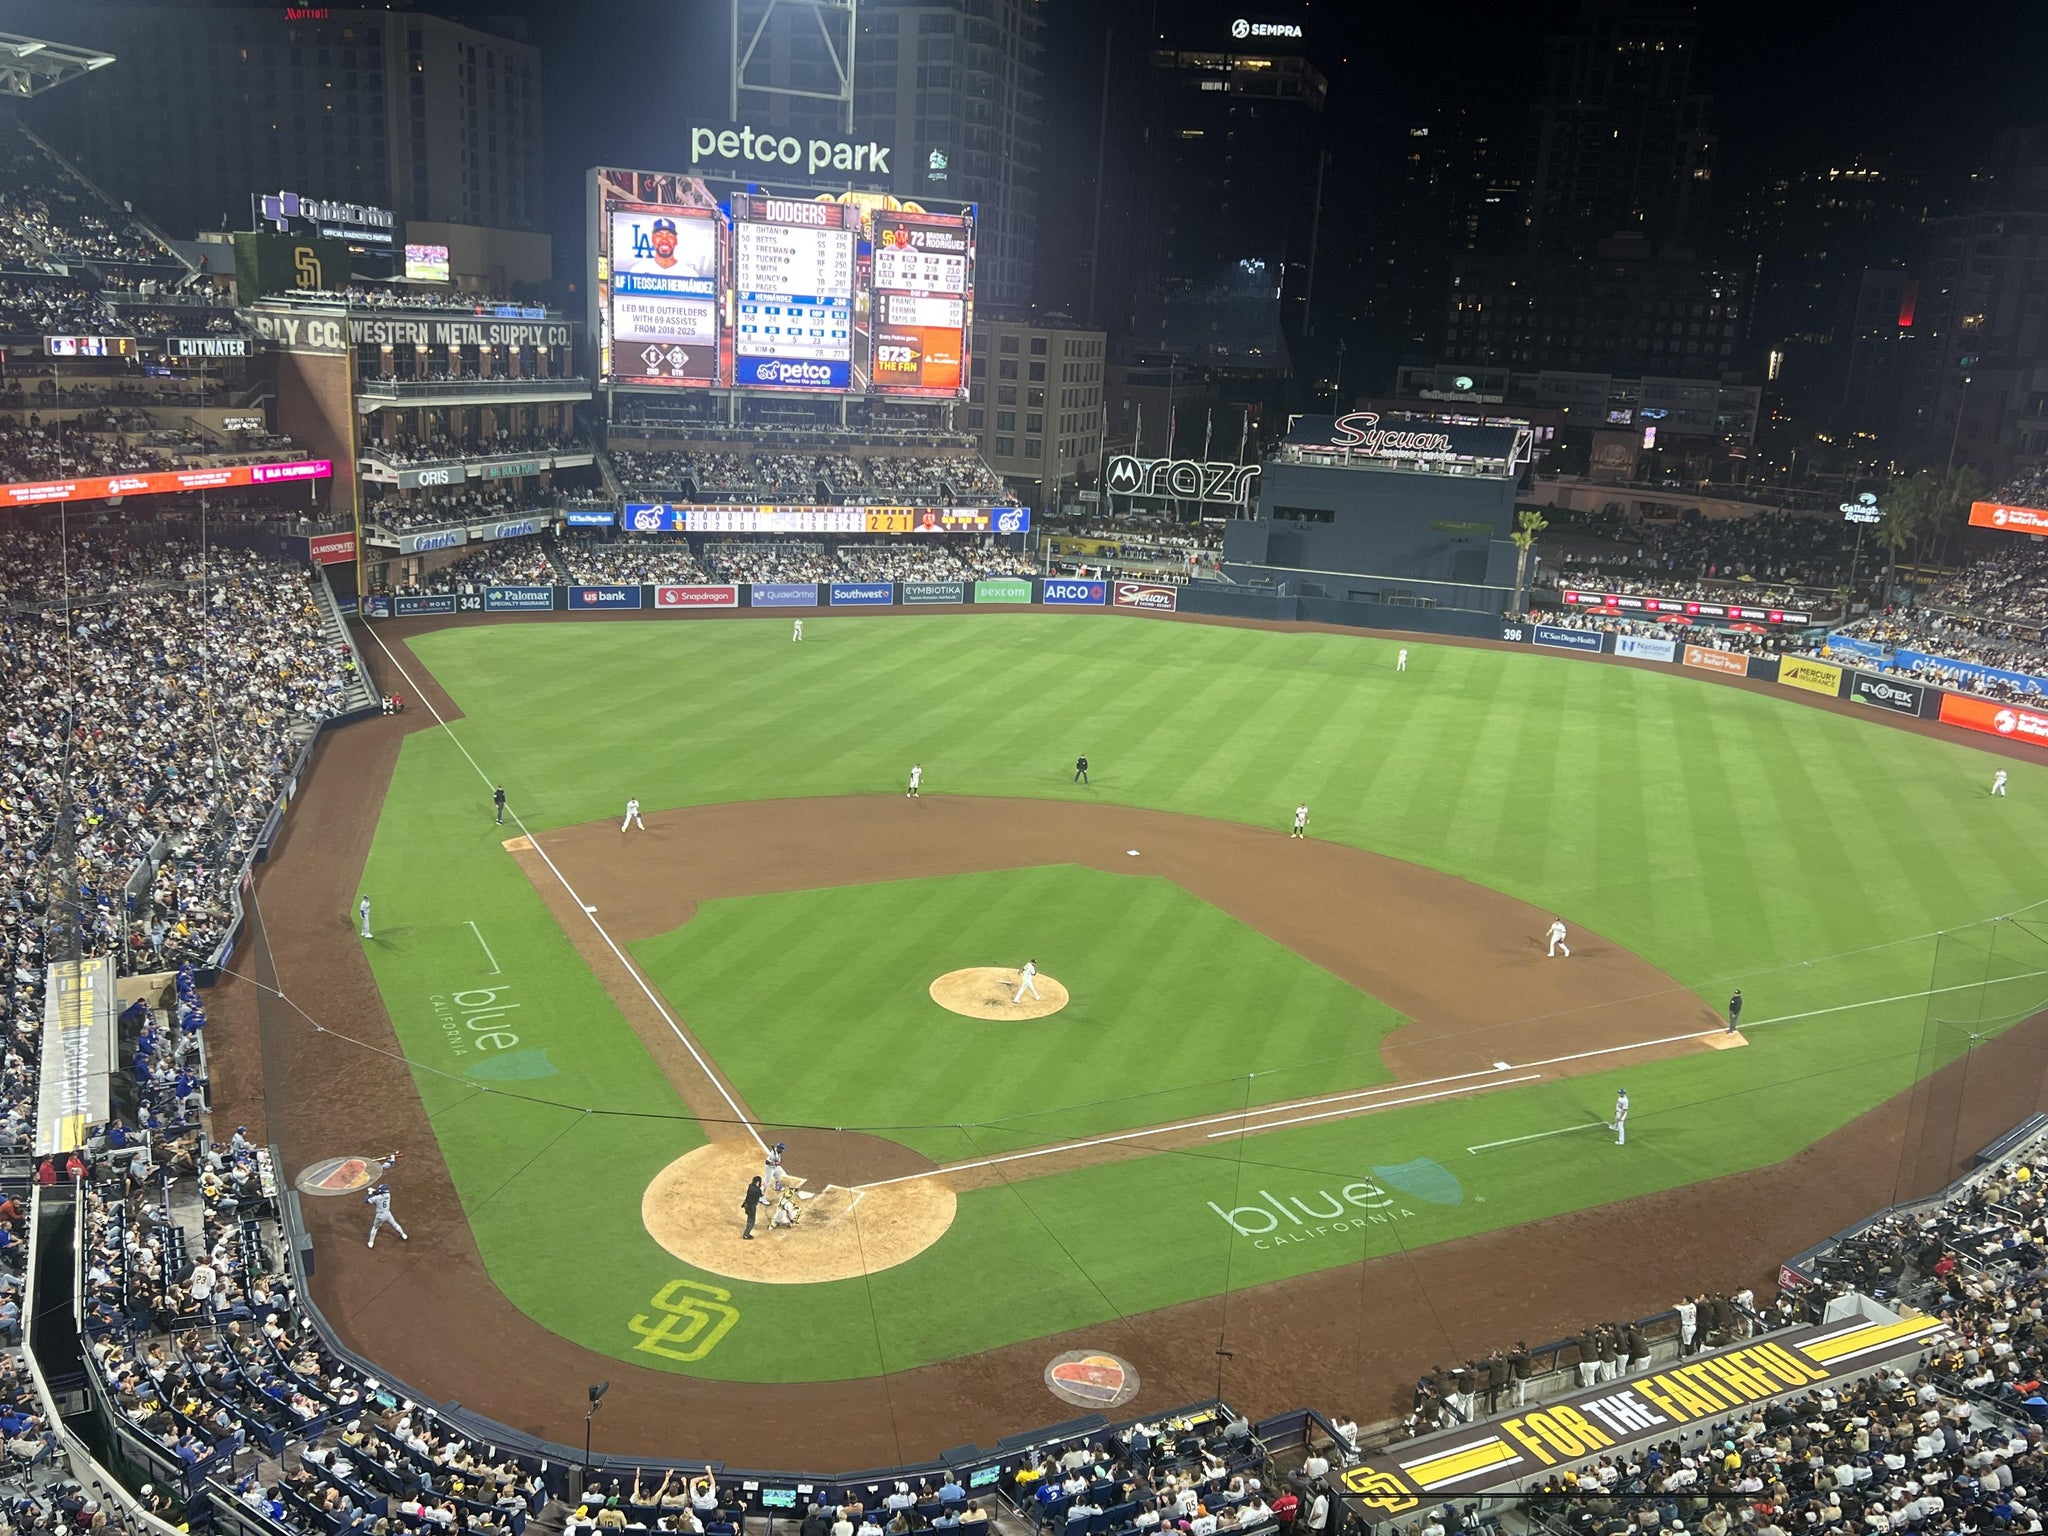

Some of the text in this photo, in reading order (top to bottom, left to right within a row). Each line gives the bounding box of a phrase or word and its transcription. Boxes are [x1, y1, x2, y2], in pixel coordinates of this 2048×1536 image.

[285, 7, 328, 20] Marriott
[1251, 23, 1302, 37] SEMPRA
[691, 125, 890, 174] petco park
[300, 197, 393, 228] QuidelOrtho
[766, 200, 826, 225] DODGERS
[756, 226, 781, 235] OHTANI
[632, 224, 656, 258] LA
[756, 236, 777, 244] BETTS
[911, 231, 925, 246] 72
[756, 245, 788, 255] FREEMAN
[741, 254, 749, 262] 23
[756, 255, 782, 263] TUCKER
[756, 265, 778, 273] SMITH
[633, 276, 667, 291] TEOSCAR
[756, 274, 780, 282] MUNCY
[756, 283, 777, 292] PAGES
[755, 293, 792, 303] HERNÁNDEZ
[891, 297, 917, 306] FRANCE
[622, 304, 707, 317] LED MLB OUTFIELDERS
[891, 307, 916, 315] FERMIN
[632, 314, 653, 324] WITH
[666, 317, 697, 327] ASSISTS
[308, 320, 347, 349] CO.
[349, 320, 570, 346] WESTERN METAL SUPPLY CO.
[634, 325, 696, 336] FROM 2018-2025
[179, 340, 246, 356] CUTWATER
[878, 345, 911, 363] 97.3
[780, 361, 831, 381] petco
[879, 361, 917, 373] THE FAN
[1331, 412, 1452, 456] Sycuan
[282, 466, 315, 477] CALIFORNIA
[419, 470, 449, 486] ORIS
[1146, 459, 1262, 503] razr
[871, 517, 908, 530] 2 2 1
[1845, 512, 1880, 523] Square
[496, 522, 533, 539] Canel's
[320, 543, 344, 552] MISSION
[414, 533, 457, 551] Canel's
[367, 550, 383, 561] 330
[504, 590, 549, 601] Palomar
[584, 591, 626, 601] us bank
[681, 592, 729, 602] Snapdragon
[767, 590, 815, 600] QuidelOrtho
[834, 589, 883, 600] Southwest
[905, 586, 961, 595] CYMBIOTIKA
[1046, 586, 1088, 599] ARCO
[1119, 585, 1170, 604] Sycuan
[460, 597, 481, 610] 342
[1578, 595, 1601, 603] TOYOTA
[1618, 599, 1642, 607] TOYOTA
[1658, 602, 1682, 611] TOYOTA
[1699, 607, 1724, 615] TOYOTA
[1741, 611, 1765, 619] TOYOTA
[1782, 614, 1807, 623] TOYOTA
[1503, 629, 1522, 641] 396
[1540, 631, 1596, 645] UC San Diego Health
[1637, 641, 1671, 653] National
[1703, 657, 1742, 671] Safari Park
[1800, 667, 1837, 681] MERCURY
[1799, 675, 1836, 688] INSURANCE
[1860, 682, 1914, 703] EVOTEK
[452, 986, 520, 1050] blue
[429, 994, 468, 1056] CALIFORNIA
[56, 1038, 94, 1076] petco
[54, 1076, 91, 1114] park
[382, 1200, 388, 1209] 6
[1206, 1183, 1394, 1236] blue
[1254, 1208, 1416, 1250] CALIFORNIA
[196, 1275, 207, 1284] 23
[628, 1279, 740, 1361] SD
[1500, 1342, 1830, 1465] FOR THE FAITHFUL
[1341, 1467, 1419, 1513] SD
[1974, 1487, 1980, 1498] 5
[1186, 1500, 1196, 1512] 05
